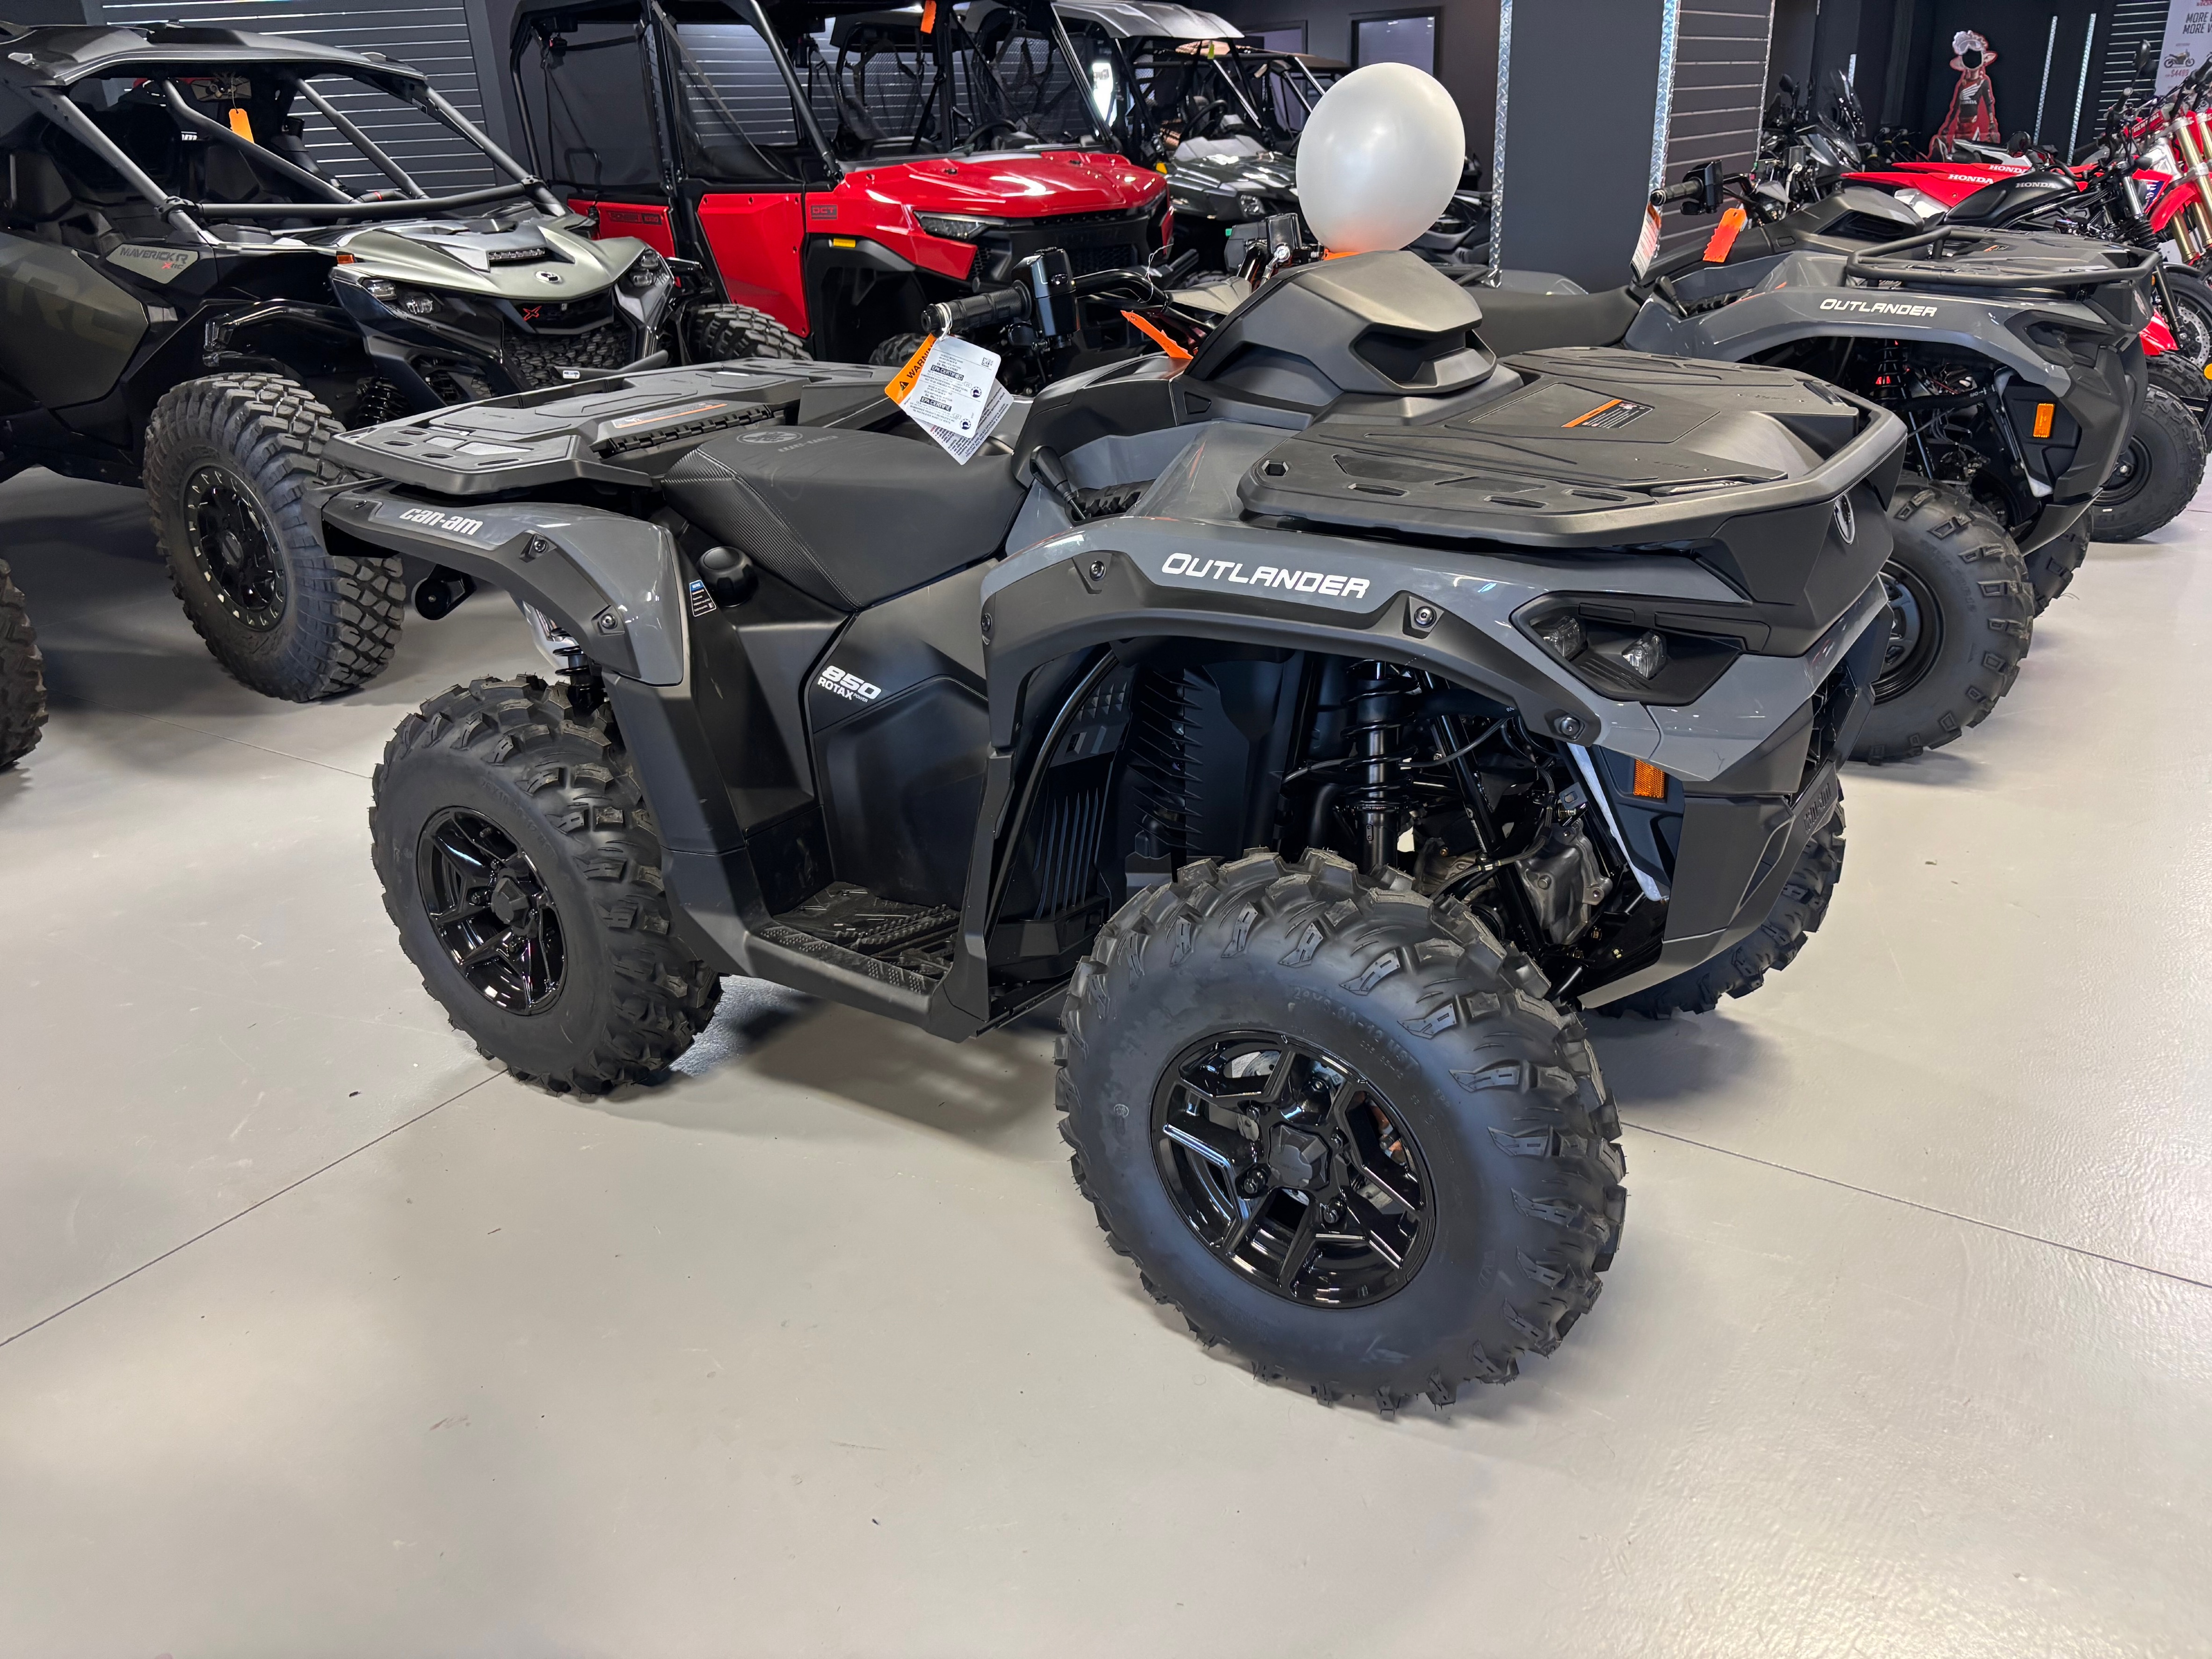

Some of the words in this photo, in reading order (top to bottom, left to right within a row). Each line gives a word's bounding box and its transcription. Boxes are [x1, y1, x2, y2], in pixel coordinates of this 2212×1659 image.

[2186, 12, 2209, 23] MORE
[2183, 23, 2207, 34] MORE
[1948, 174, 1994, 184] HONDA
[120, 247, 175, 262] MAVERICK
[1820, 298, 1937, 317] OUTLANDER
[399, 508, 483, 535] can-am
[1161, 553, 1370, 599] OUTLANDER
[818, 677, 854, 700] ROTAX
[853, 693, 868, 702] POWER
[822, 665, 881, 699] 850
